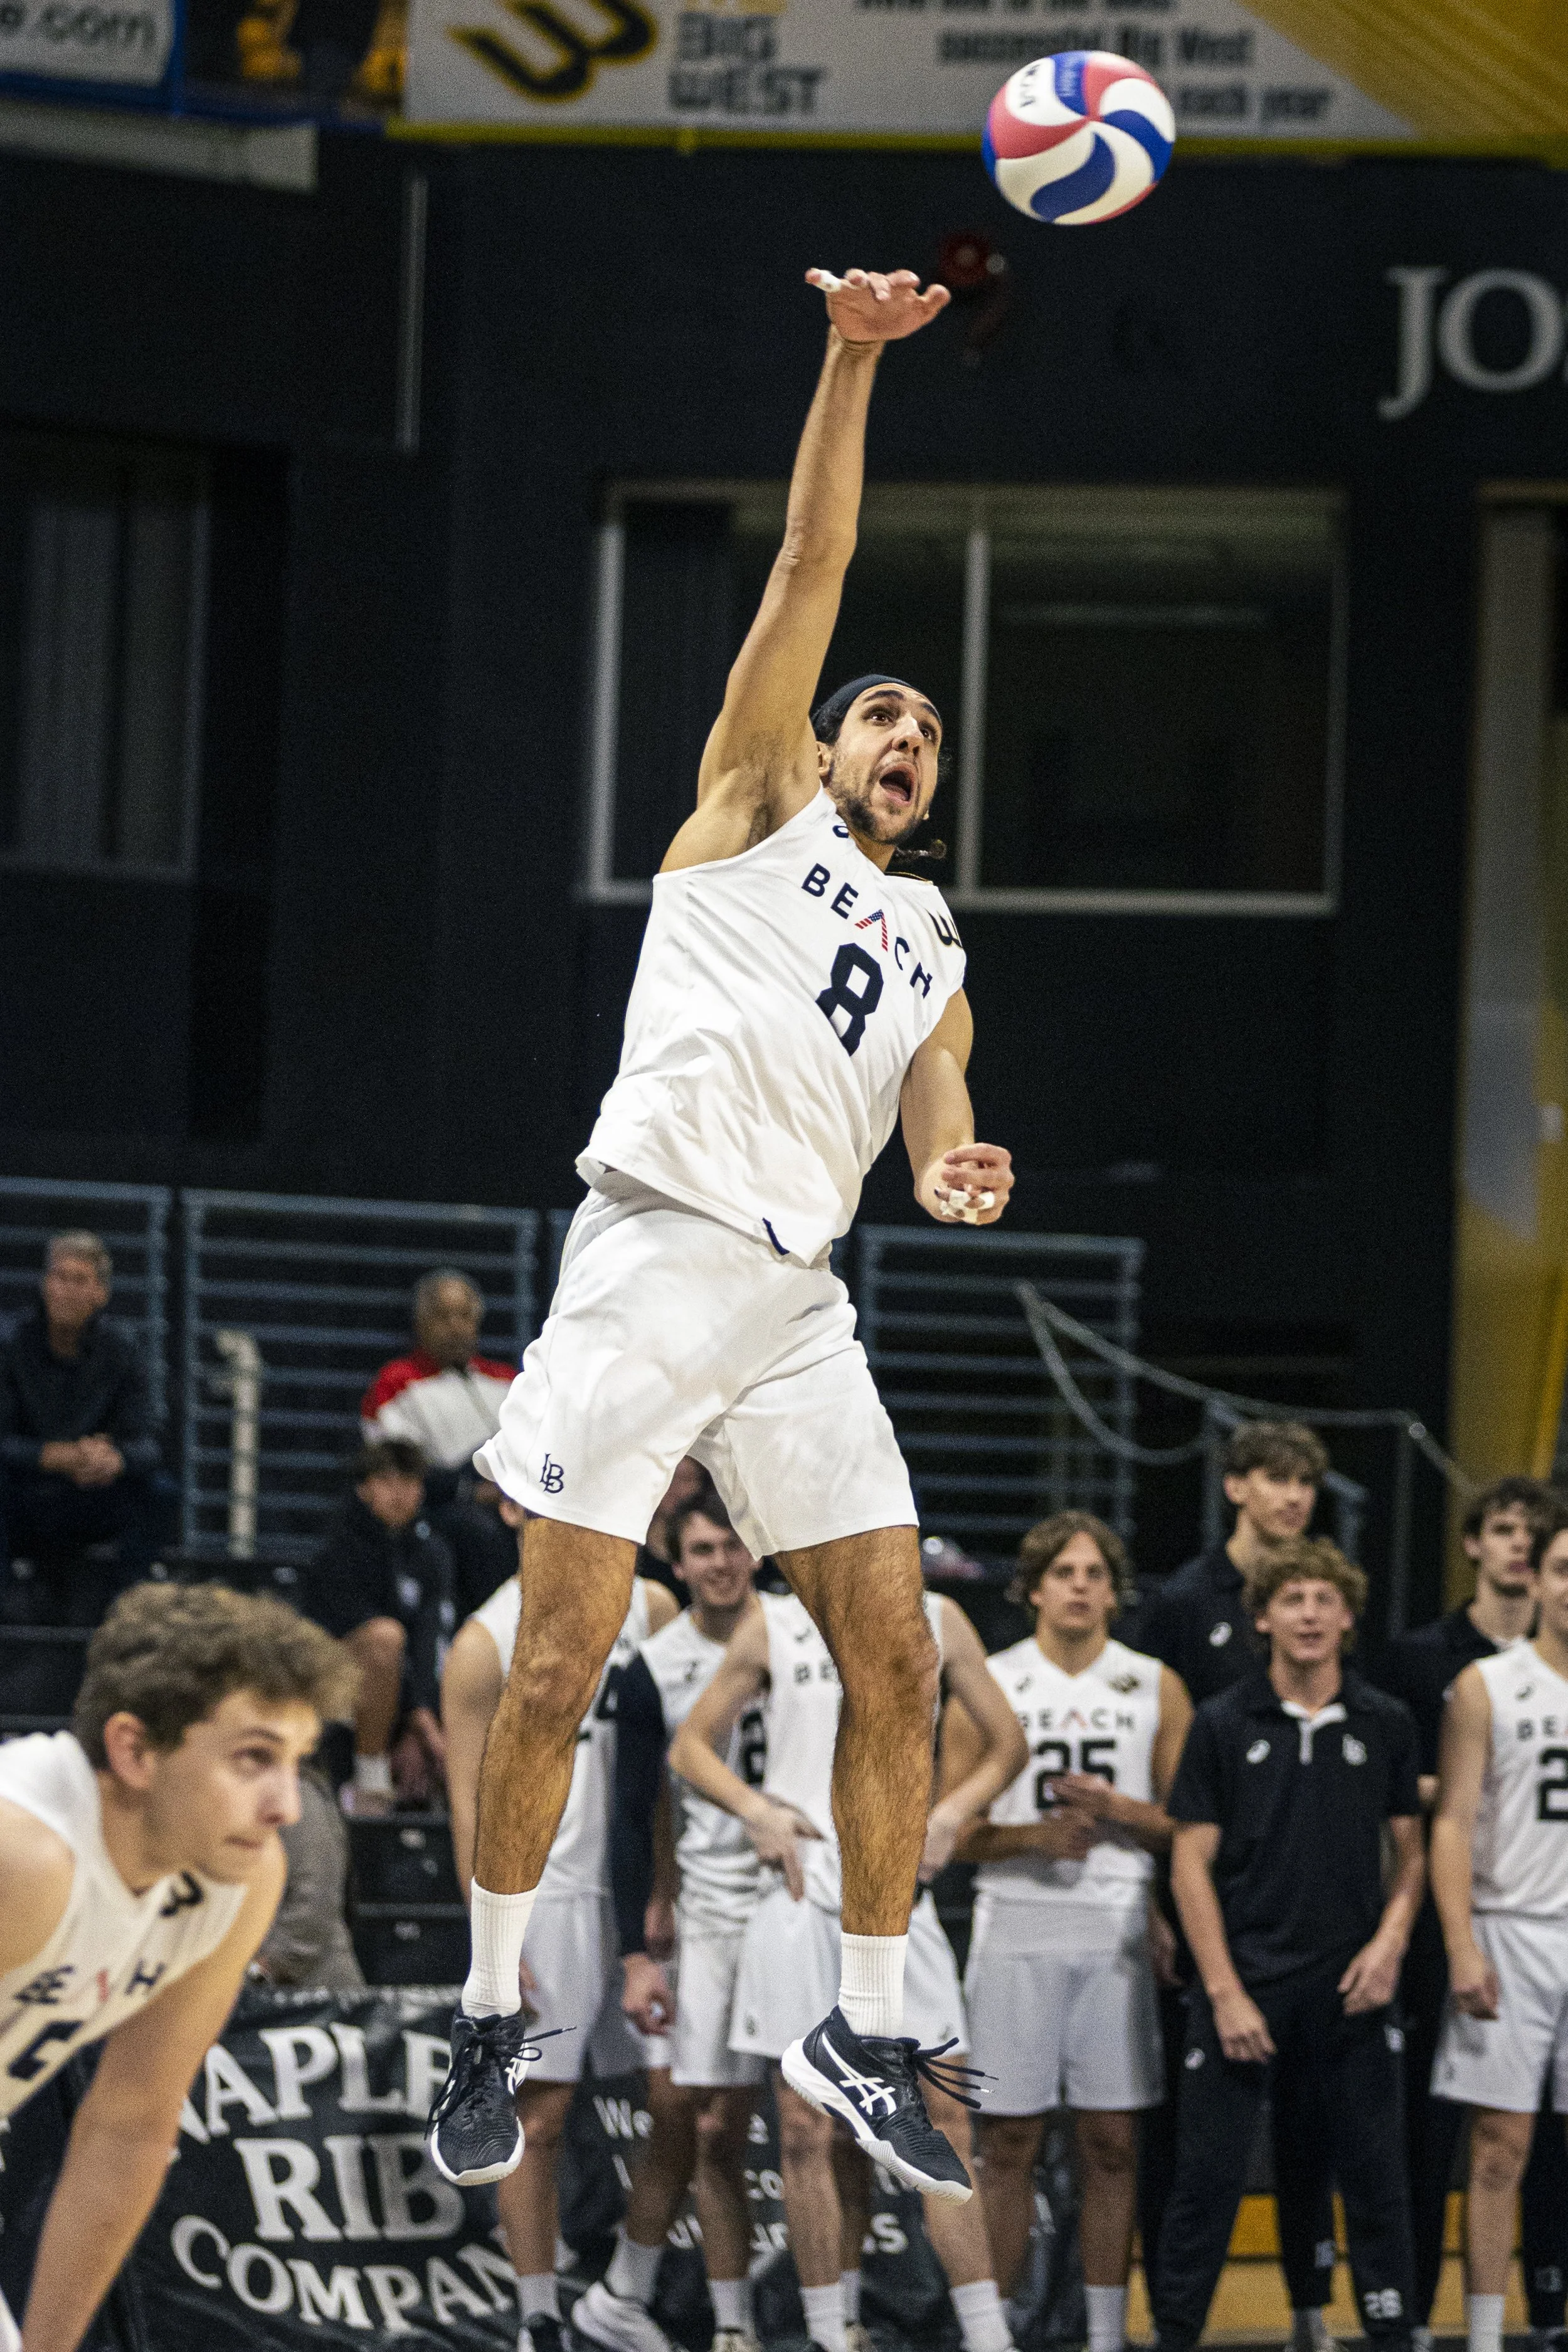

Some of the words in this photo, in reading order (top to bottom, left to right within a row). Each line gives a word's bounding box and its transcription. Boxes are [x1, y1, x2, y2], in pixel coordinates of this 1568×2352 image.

[669, 66, 825, 114] WEST
[1378, 264, 1568, 421] JO
[801, 863, 933, 999] BEACH
[815, 943, 884, 1057] 8
[539, 1453, 564, 1494] LB
[180, 2021, 452, 2145] APL
[233, 2134, 465, 2242] RIB
[171, 2214, 564, 2333] COMPAN
